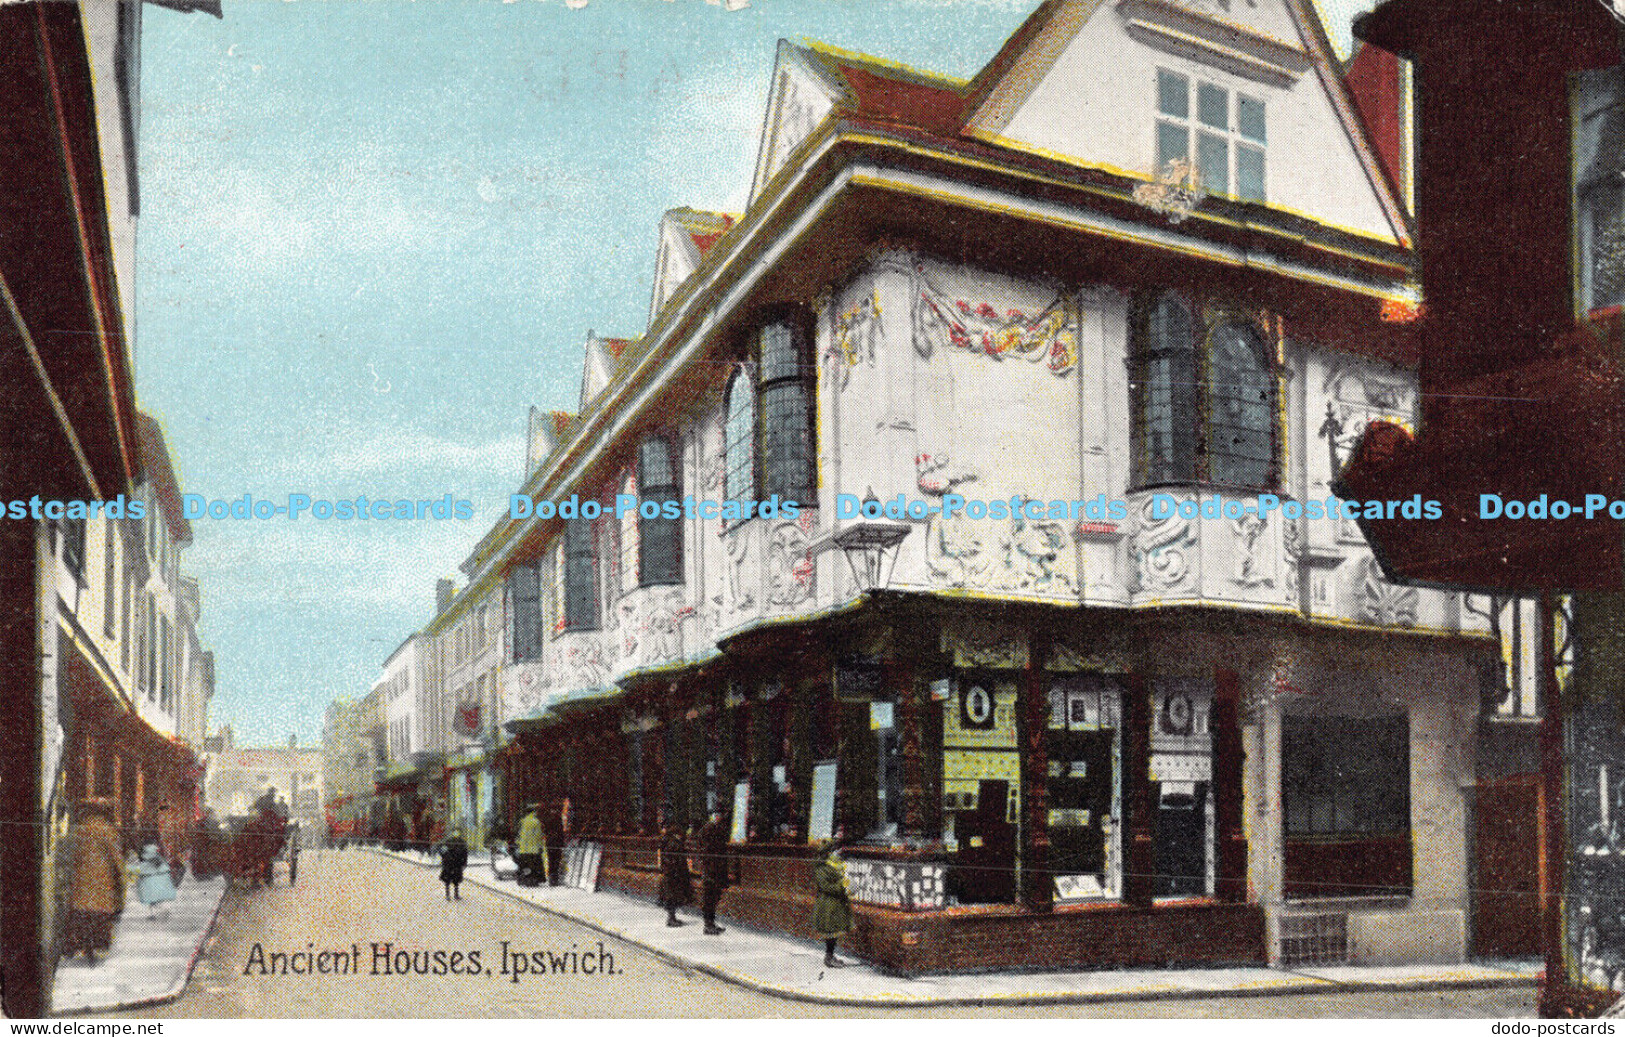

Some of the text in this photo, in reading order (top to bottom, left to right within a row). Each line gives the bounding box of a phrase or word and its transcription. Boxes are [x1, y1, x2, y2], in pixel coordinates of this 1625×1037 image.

[243, 942, 624, 984] Ancient Houses, Ipswich.
